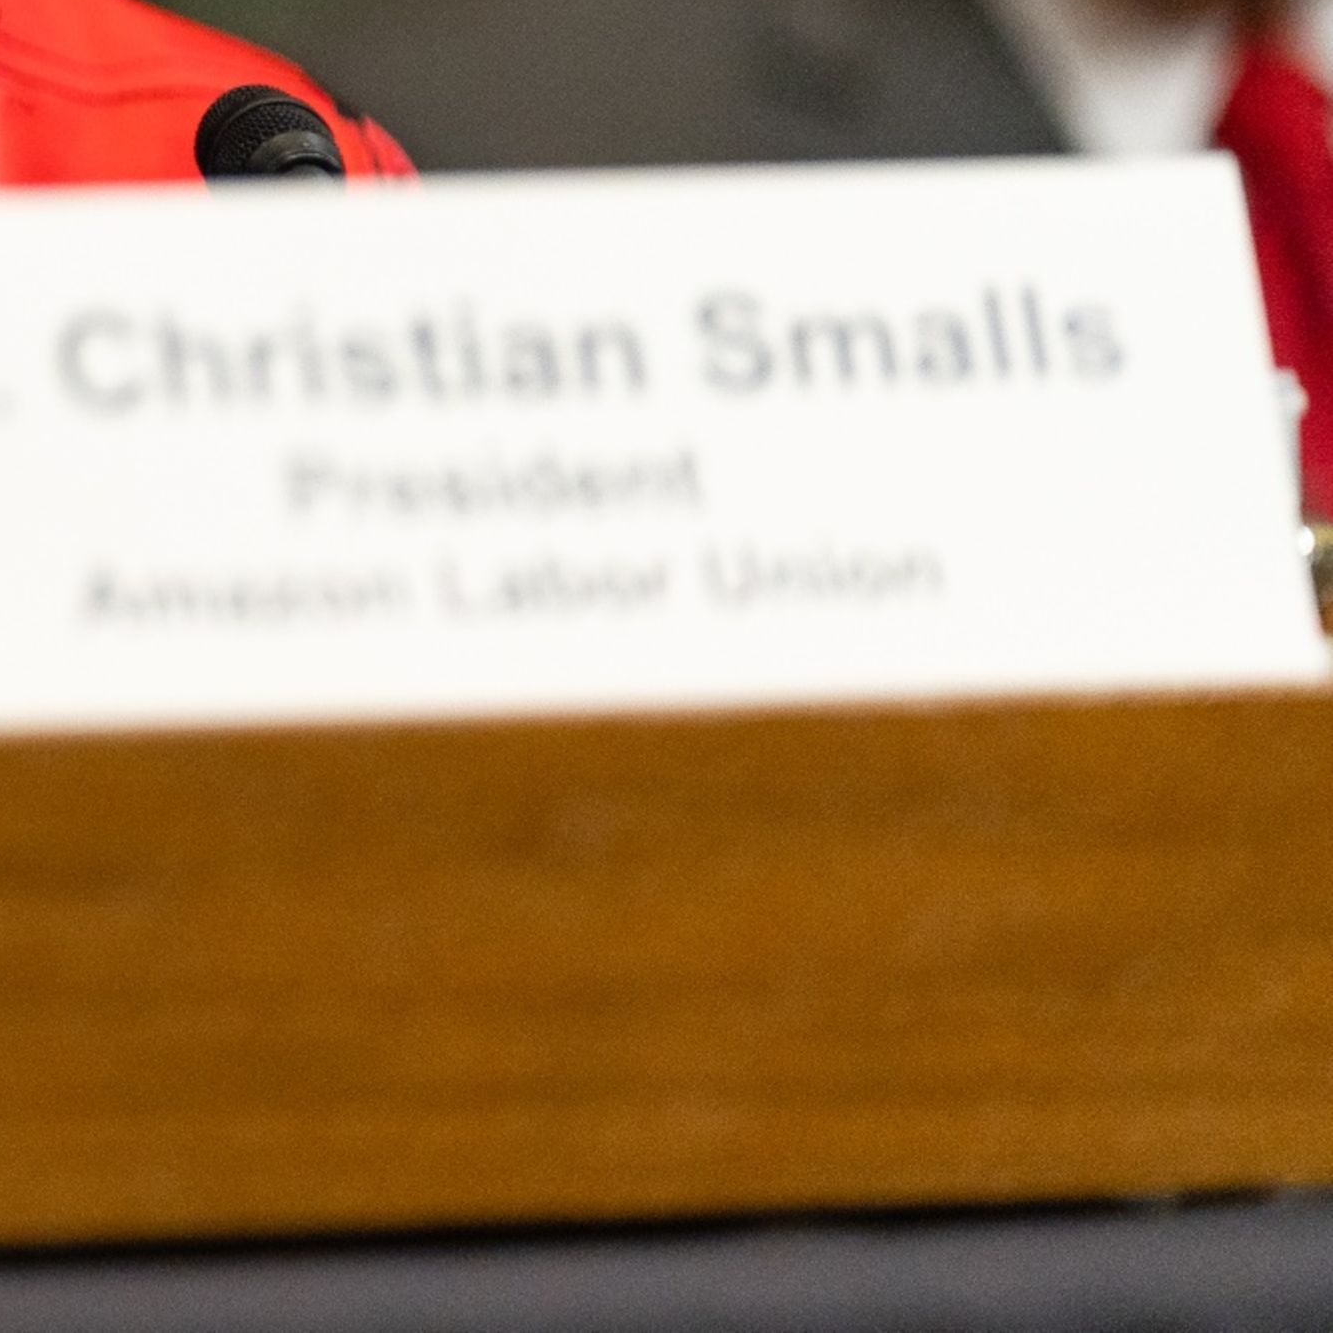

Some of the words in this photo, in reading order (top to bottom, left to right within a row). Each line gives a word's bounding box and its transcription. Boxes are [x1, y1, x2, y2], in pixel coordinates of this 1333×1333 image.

[55, 298, 649, 412] Christian
[693, 282, 1126, 394] Smalls
[283, 444, 702, 517] President
[80, 558, 413, 624] Amazon
[435, 542, 671, 618] Labor
[699, 536, 945, 610] Union
